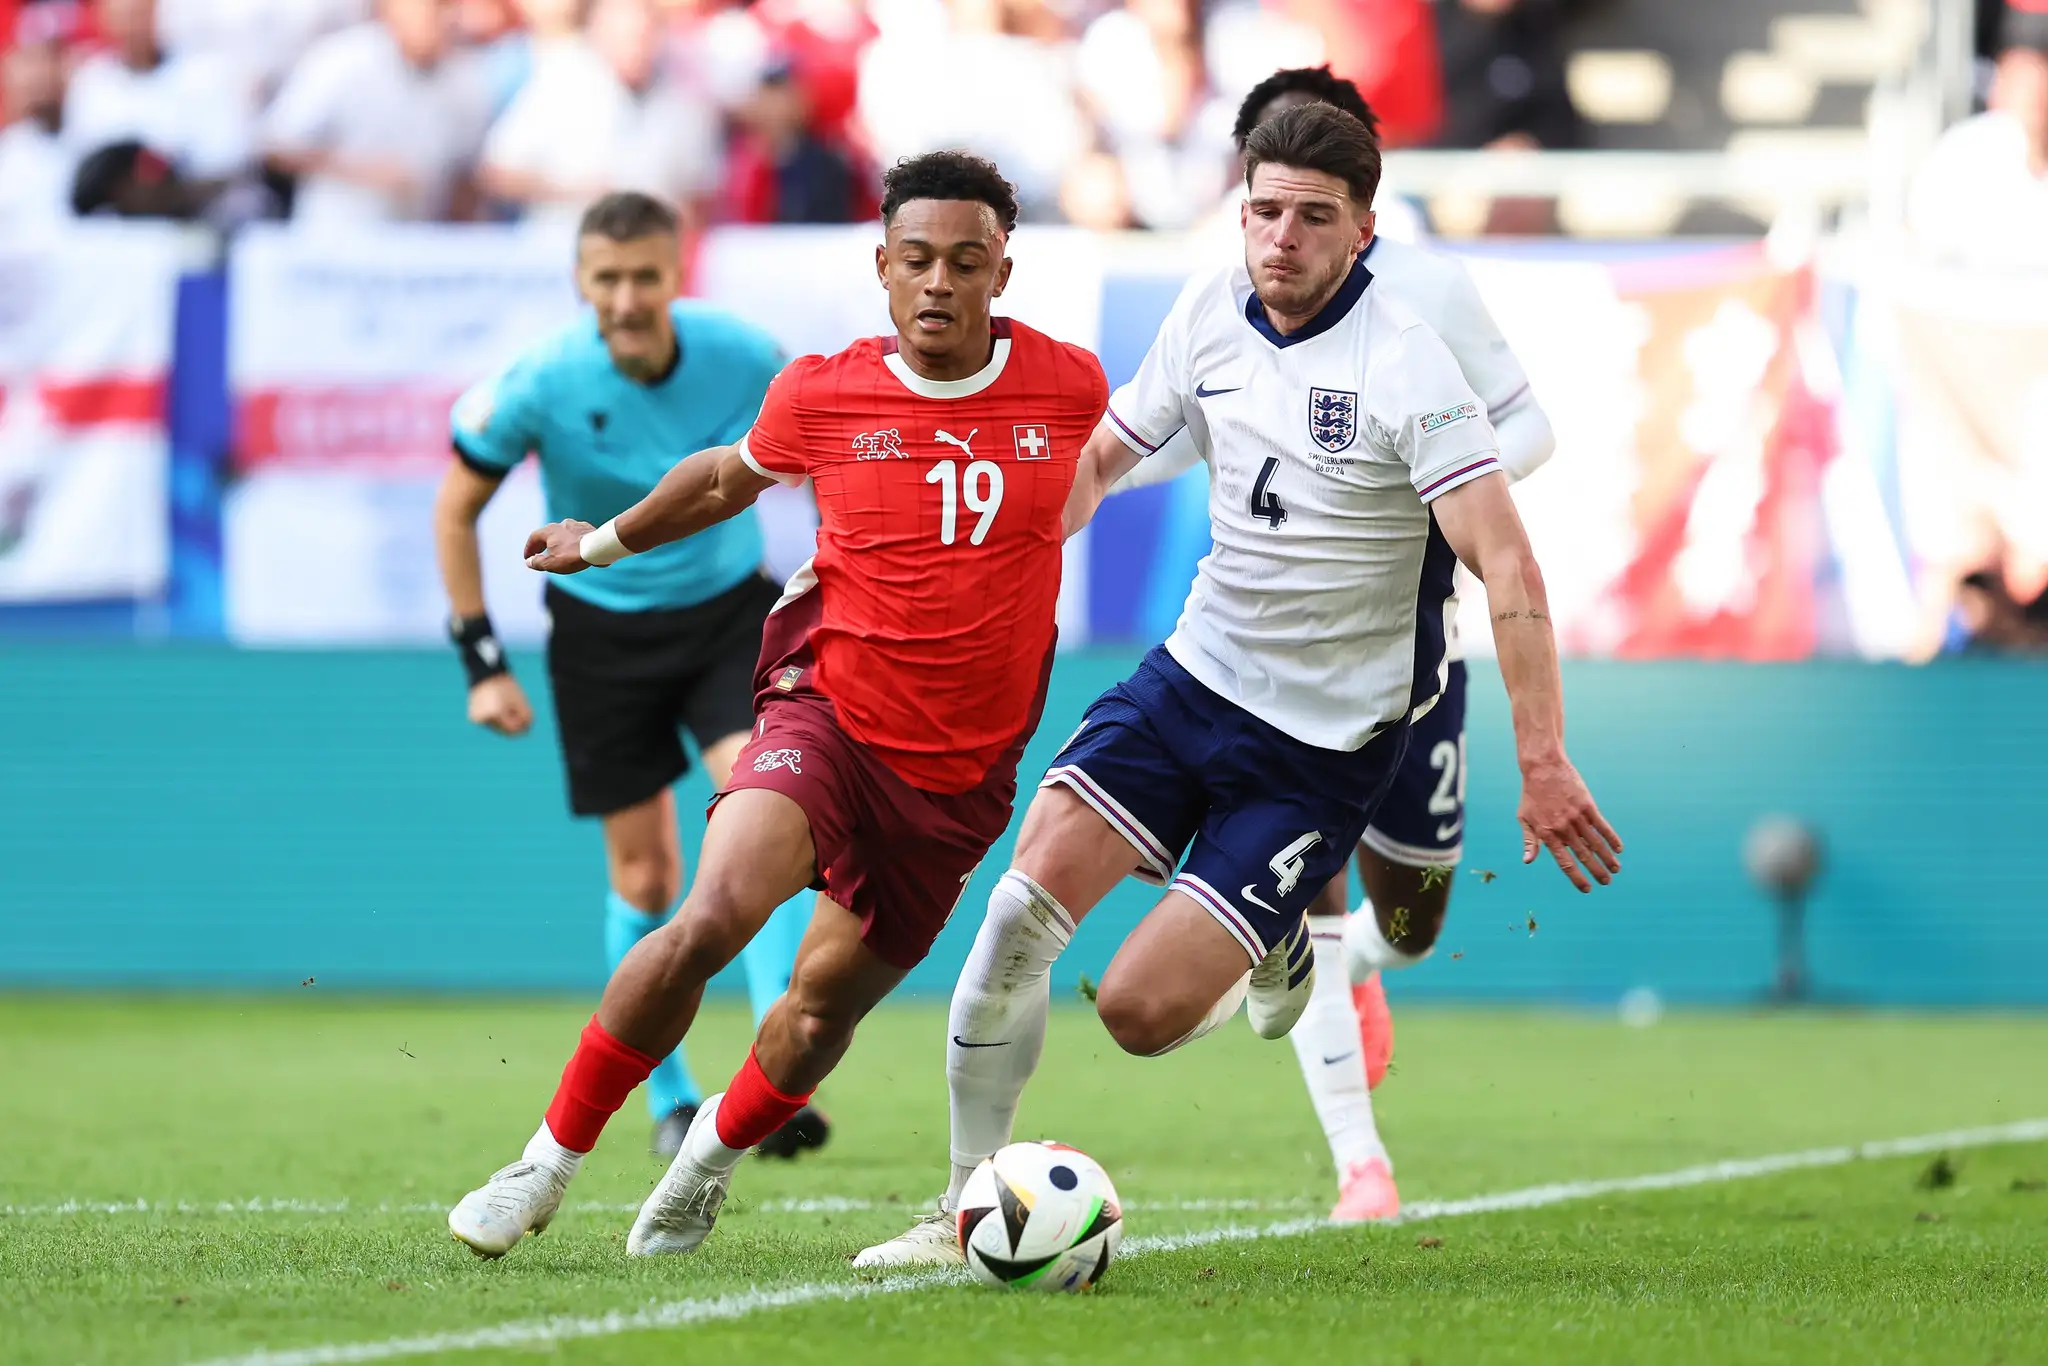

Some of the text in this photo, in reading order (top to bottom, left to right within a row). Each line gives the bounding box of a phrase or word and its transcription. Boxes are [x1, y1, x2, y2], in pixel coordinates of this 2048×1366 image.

[1419, 412, 1434, 422] UEFA
[1421, 404, 1477, 430] FOUNDATION
[1307, 452, 1355, 465] SWITZERLAND
[1315, 463, 1345, 475] 06.07.24
[925, 459, 1004, 546] 19
[1251, 456, 1288, 531] 4
[1269, 830, 1322, 897] 4
